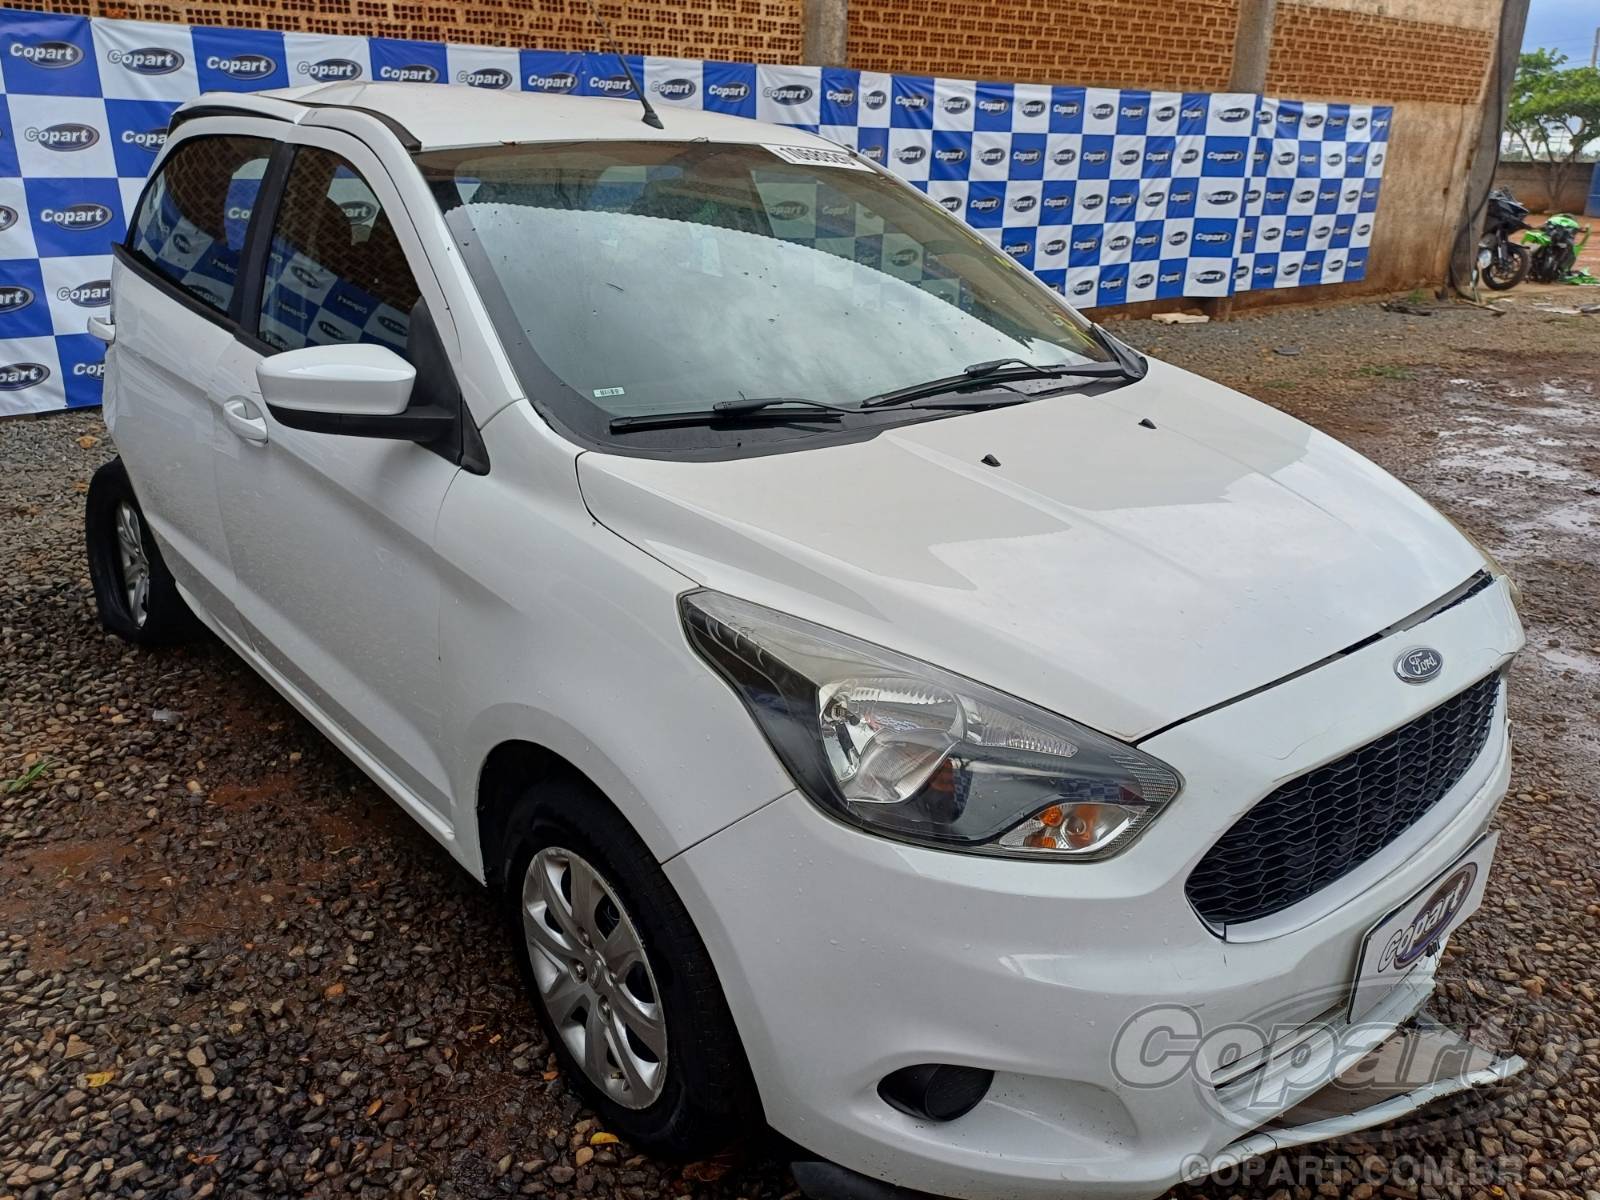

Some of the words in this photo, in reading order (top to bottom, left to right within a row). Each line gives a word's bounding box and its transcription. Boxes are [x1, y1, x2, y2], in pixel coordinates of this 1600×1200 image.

[10, 43, 74, 61] Copart
[107, 50, 174, 67] Copart
[206, 56, 267, 73] Copart
[297, 61, 353, 77] Copart
[380, 66, 432, 81] Copart
[457, 71, 505, 85] Copart
[528, 75, 573, 89] Copart
[589, 77, 632, 91] Copart
[650, 81, 691, 95] Copart
[708, 85, 746, 97] Copart
[763, 87, 806, 100] Copart
[826, 89, 854, 103] Copart
[895, 96, 925, 107] Copart
[978, 101, 1005, 111] Copart
[1053, 104, 1078, 114] Copart
[24, 127, 88, 144] Copart
[122, 130, 168, 146] Copa
[935, 150, 964, 161] Copart
[1013, 152, 1039, 162] Copart
[1083, 152, 1106, 161] Copart
[1207, 151, 1239, 161] Copart
[970, 200, 997, 210] Copart
[1044, 198, 1068, 207] Copart
[1110, 196, 1132, 205] Copart
[40, 209, 103, 224] Copart
[1195, 233, 1227, 242] Copart
[1073, 241, 1096, 250] Copart
[57, 286, 109, 302] Copar
[73, 363, 104, 377] Cop
[1408, 652, 1437, 674] Ford
[1378, 871, 1469, 974] Copart
